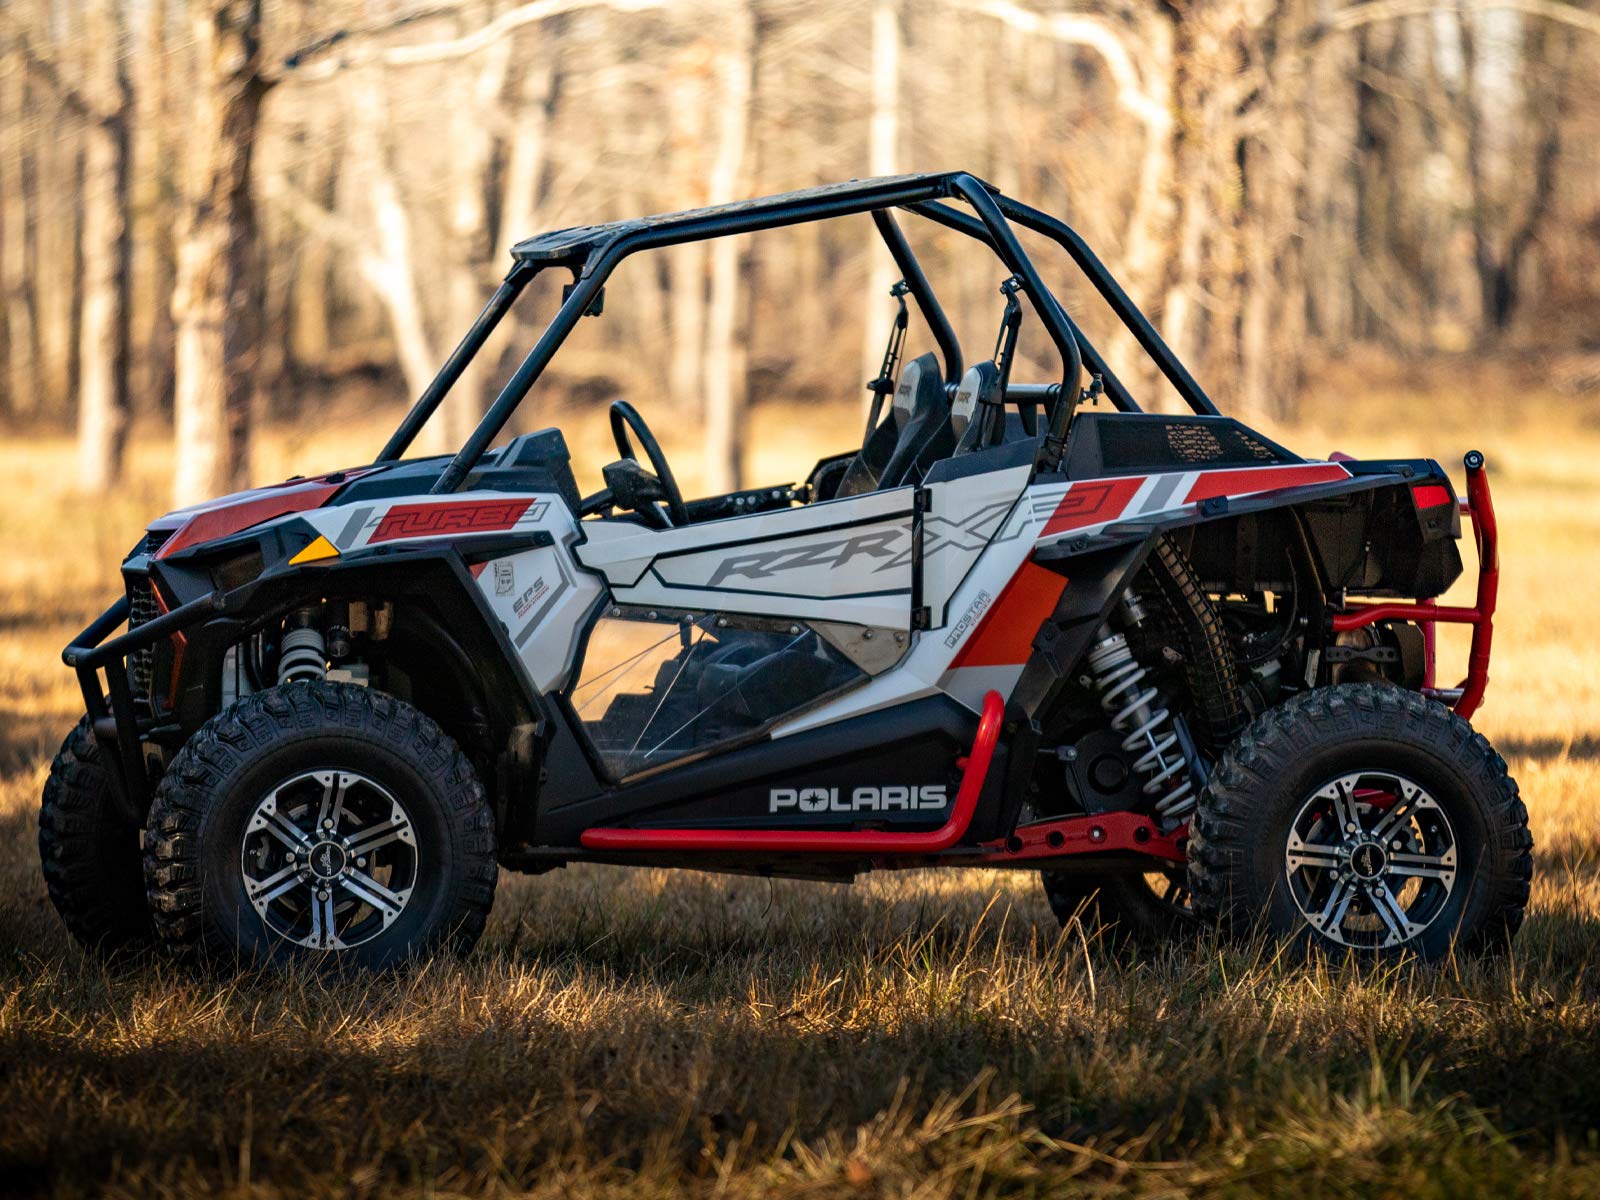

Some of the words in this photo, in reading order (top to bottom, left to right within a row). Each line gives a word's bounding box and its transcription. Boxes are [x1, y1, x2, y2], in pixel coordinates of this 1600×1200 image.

[365, 501, 551, 538] TURBO
[706, 529, 903, 586] RZR
[513, 576, 543, 613] EPS
[944, 590, 991, 648] PROSTAR
[769, 785, 947, 812] POLARIS
